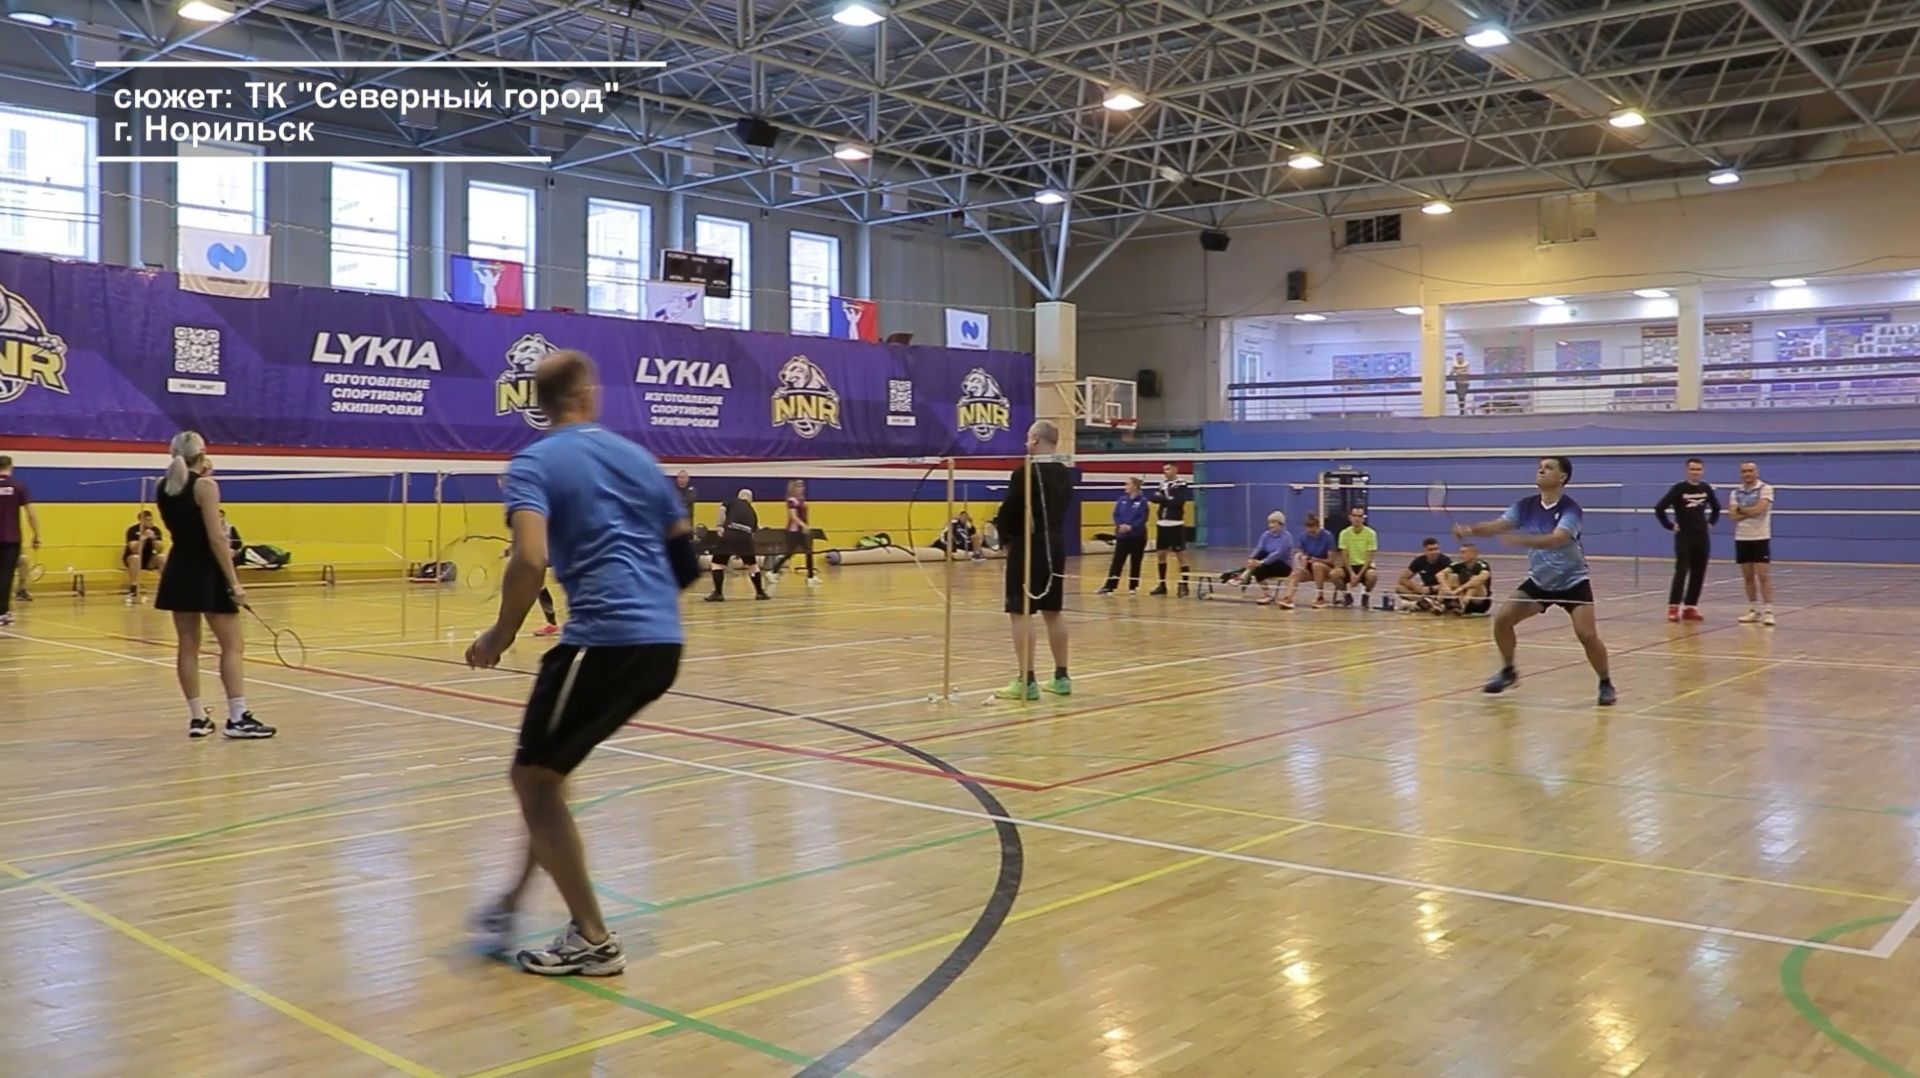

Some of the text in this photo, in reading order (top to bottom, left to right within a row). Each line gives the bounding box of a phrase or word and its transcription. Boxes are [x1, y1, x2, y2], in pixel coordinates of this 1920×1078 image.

[312, 332, 442, 371] LYKIA
[323, 372, 431, 389] ИЗГОТОВЛЕНИЕ
[635, 357, 732, 389] LYKIA
[331, 387, 424, 402] СПОРТИВНОЙ
[331, 401, 424, 416] ЭКИПИРОВКИ
[773, 394, 840, 425] NNR
[958, 402, 1010, 428] NNR
